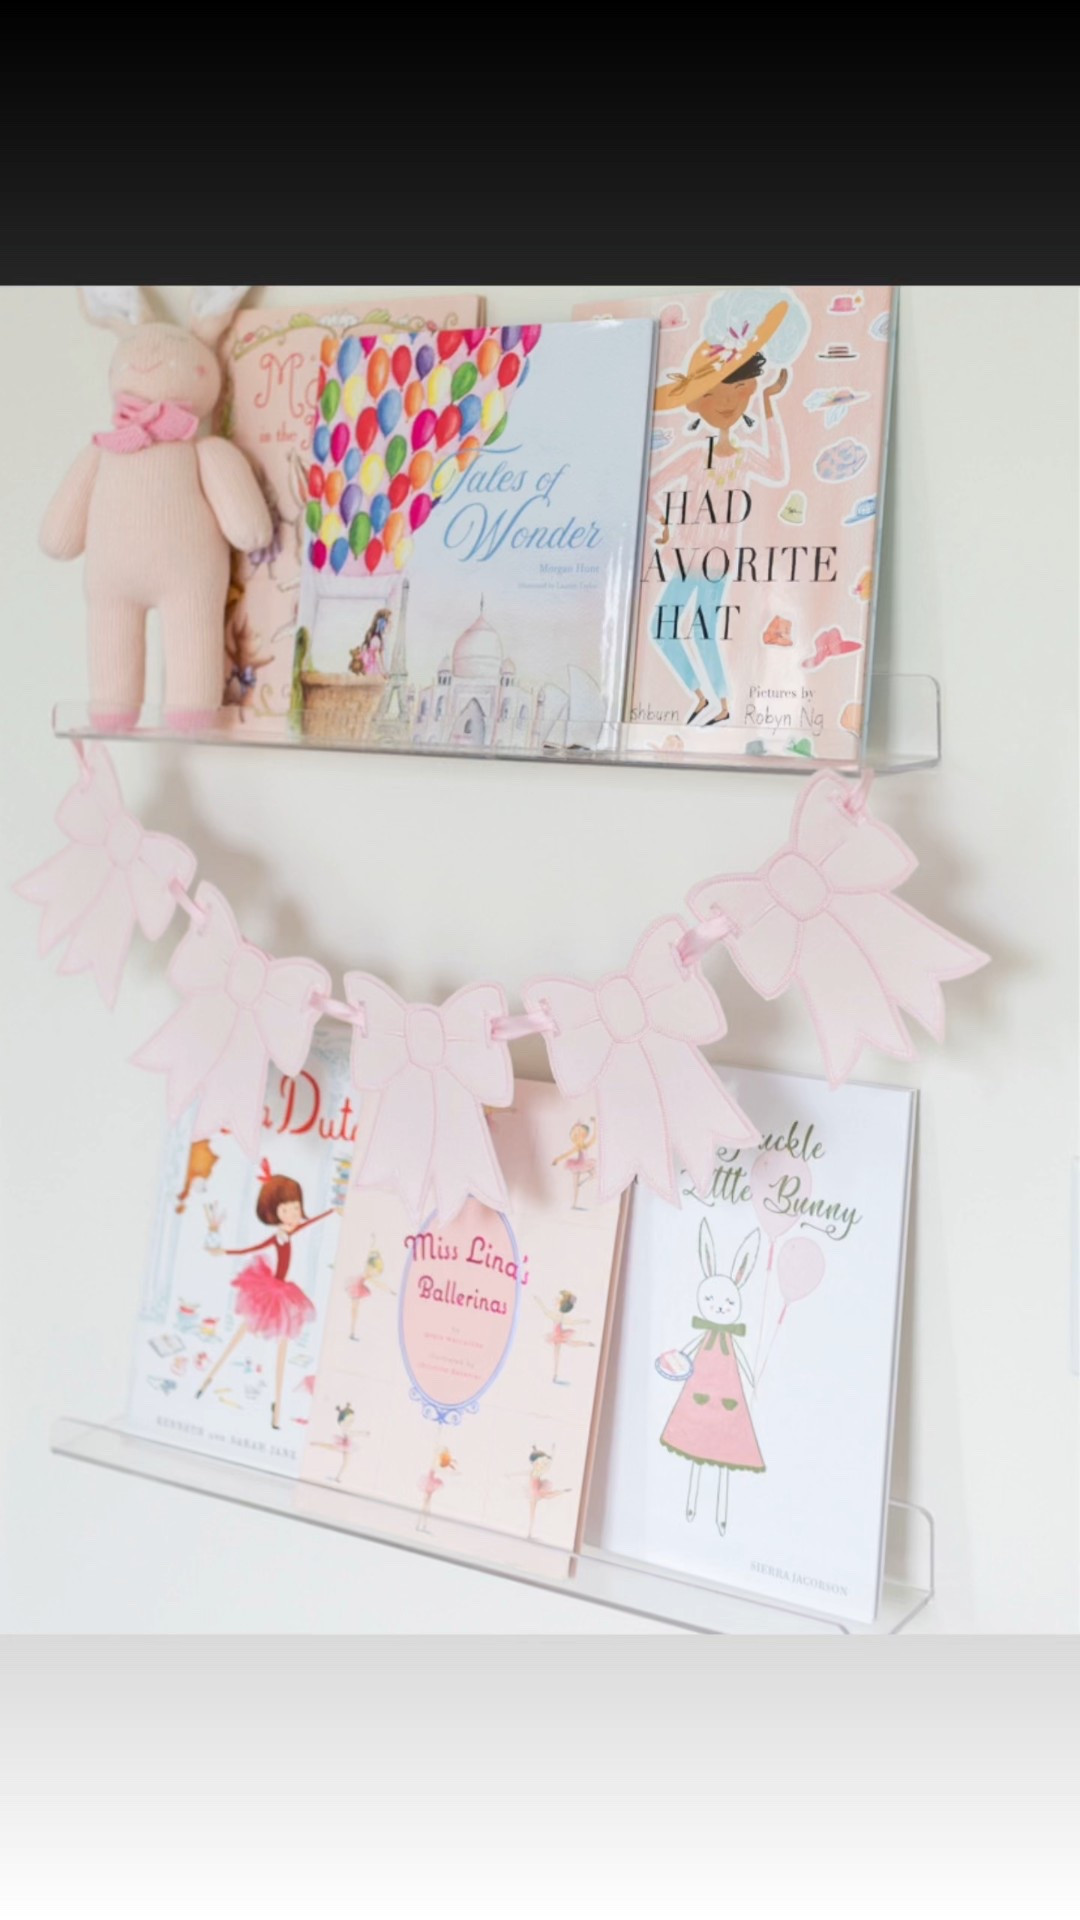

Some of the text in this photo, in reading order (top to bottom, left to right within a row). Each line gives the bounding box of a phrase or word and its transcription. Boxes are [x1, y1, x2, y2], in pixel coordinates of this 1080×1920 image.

[704, 435, 718, 471] I
[431, 444, 571, 504] Tales of
[663, 489, 752, 525] HAD
[443, 495, 603, 562] Wonder
[640, 546, 838, 583] AVORITE
[653, 605, 741, 640] HAT
[749, 686, 815, 702] Pictures by
[630, 703, 824, 736] shburn Robyn Ng
[763, 1175, 863, 1240] Bunny
[404, 1232, 529, 1285] Miss Lina's
[418, 1275, 507, 1315] Ballerinas
[750, 1560, 790, 1581] SIERRA
